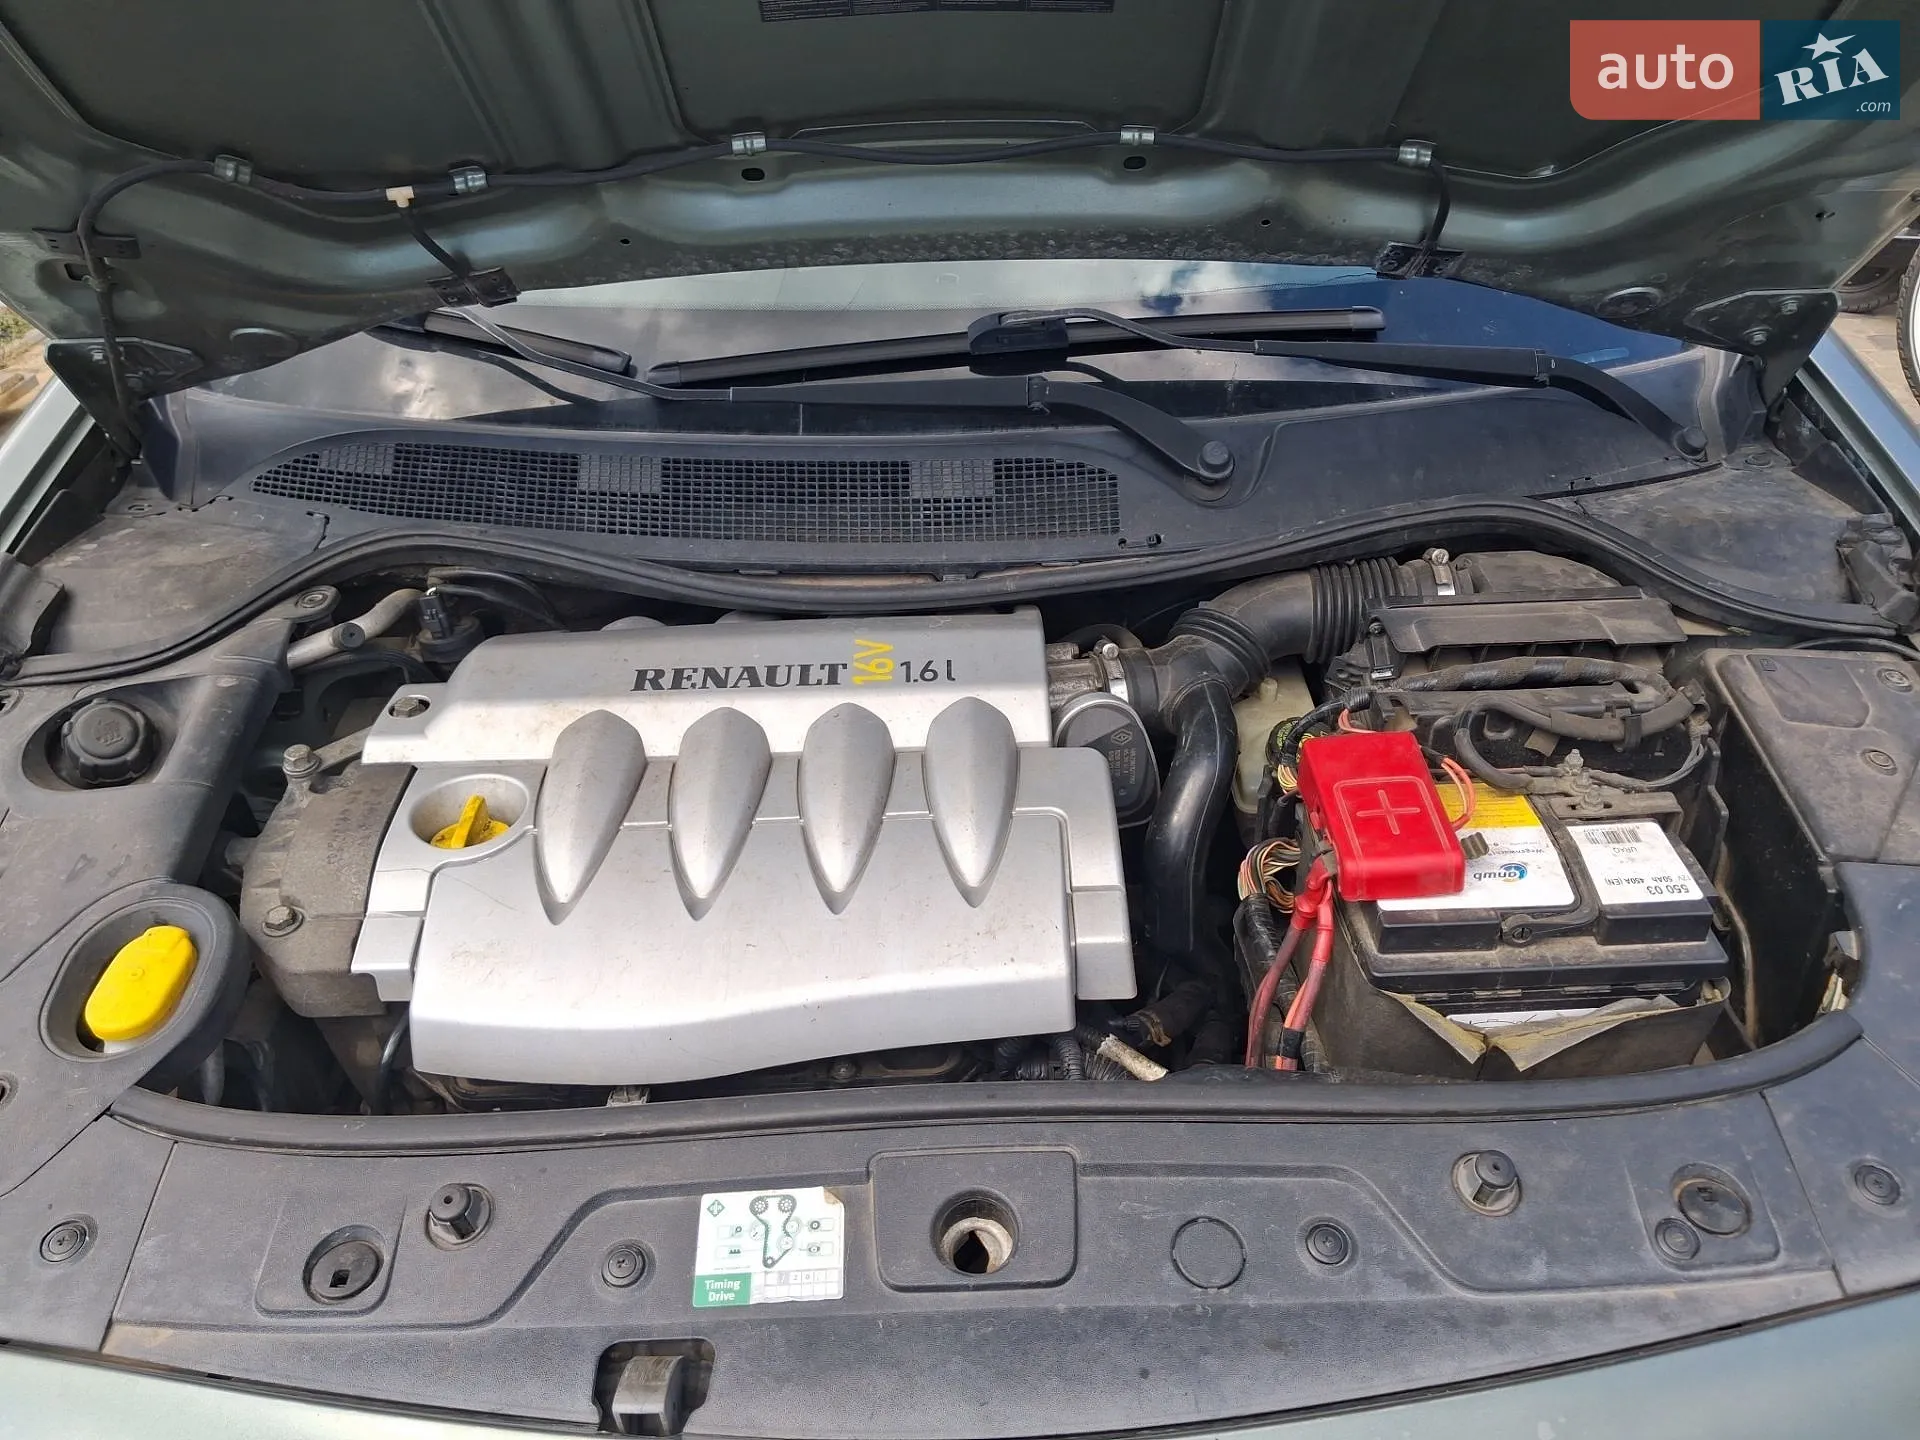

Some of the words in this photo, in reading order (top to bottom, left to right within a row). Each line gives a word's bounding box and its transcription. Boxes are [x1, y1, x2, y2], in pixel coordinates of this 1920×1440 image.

[852, 639, 895, 685] 16V
[630, 663, 848, 692] RENAULT
[1473, 870, 1518, 882] anwb
[1651, 875, 1673, 884] 50Ah
[1646, 885, 1664, 895] 03
[1665, 884, 1690, 894] 550
[705, 1278, 741, 1291] Timing
[708, 1291, 735, 1301] Drive
